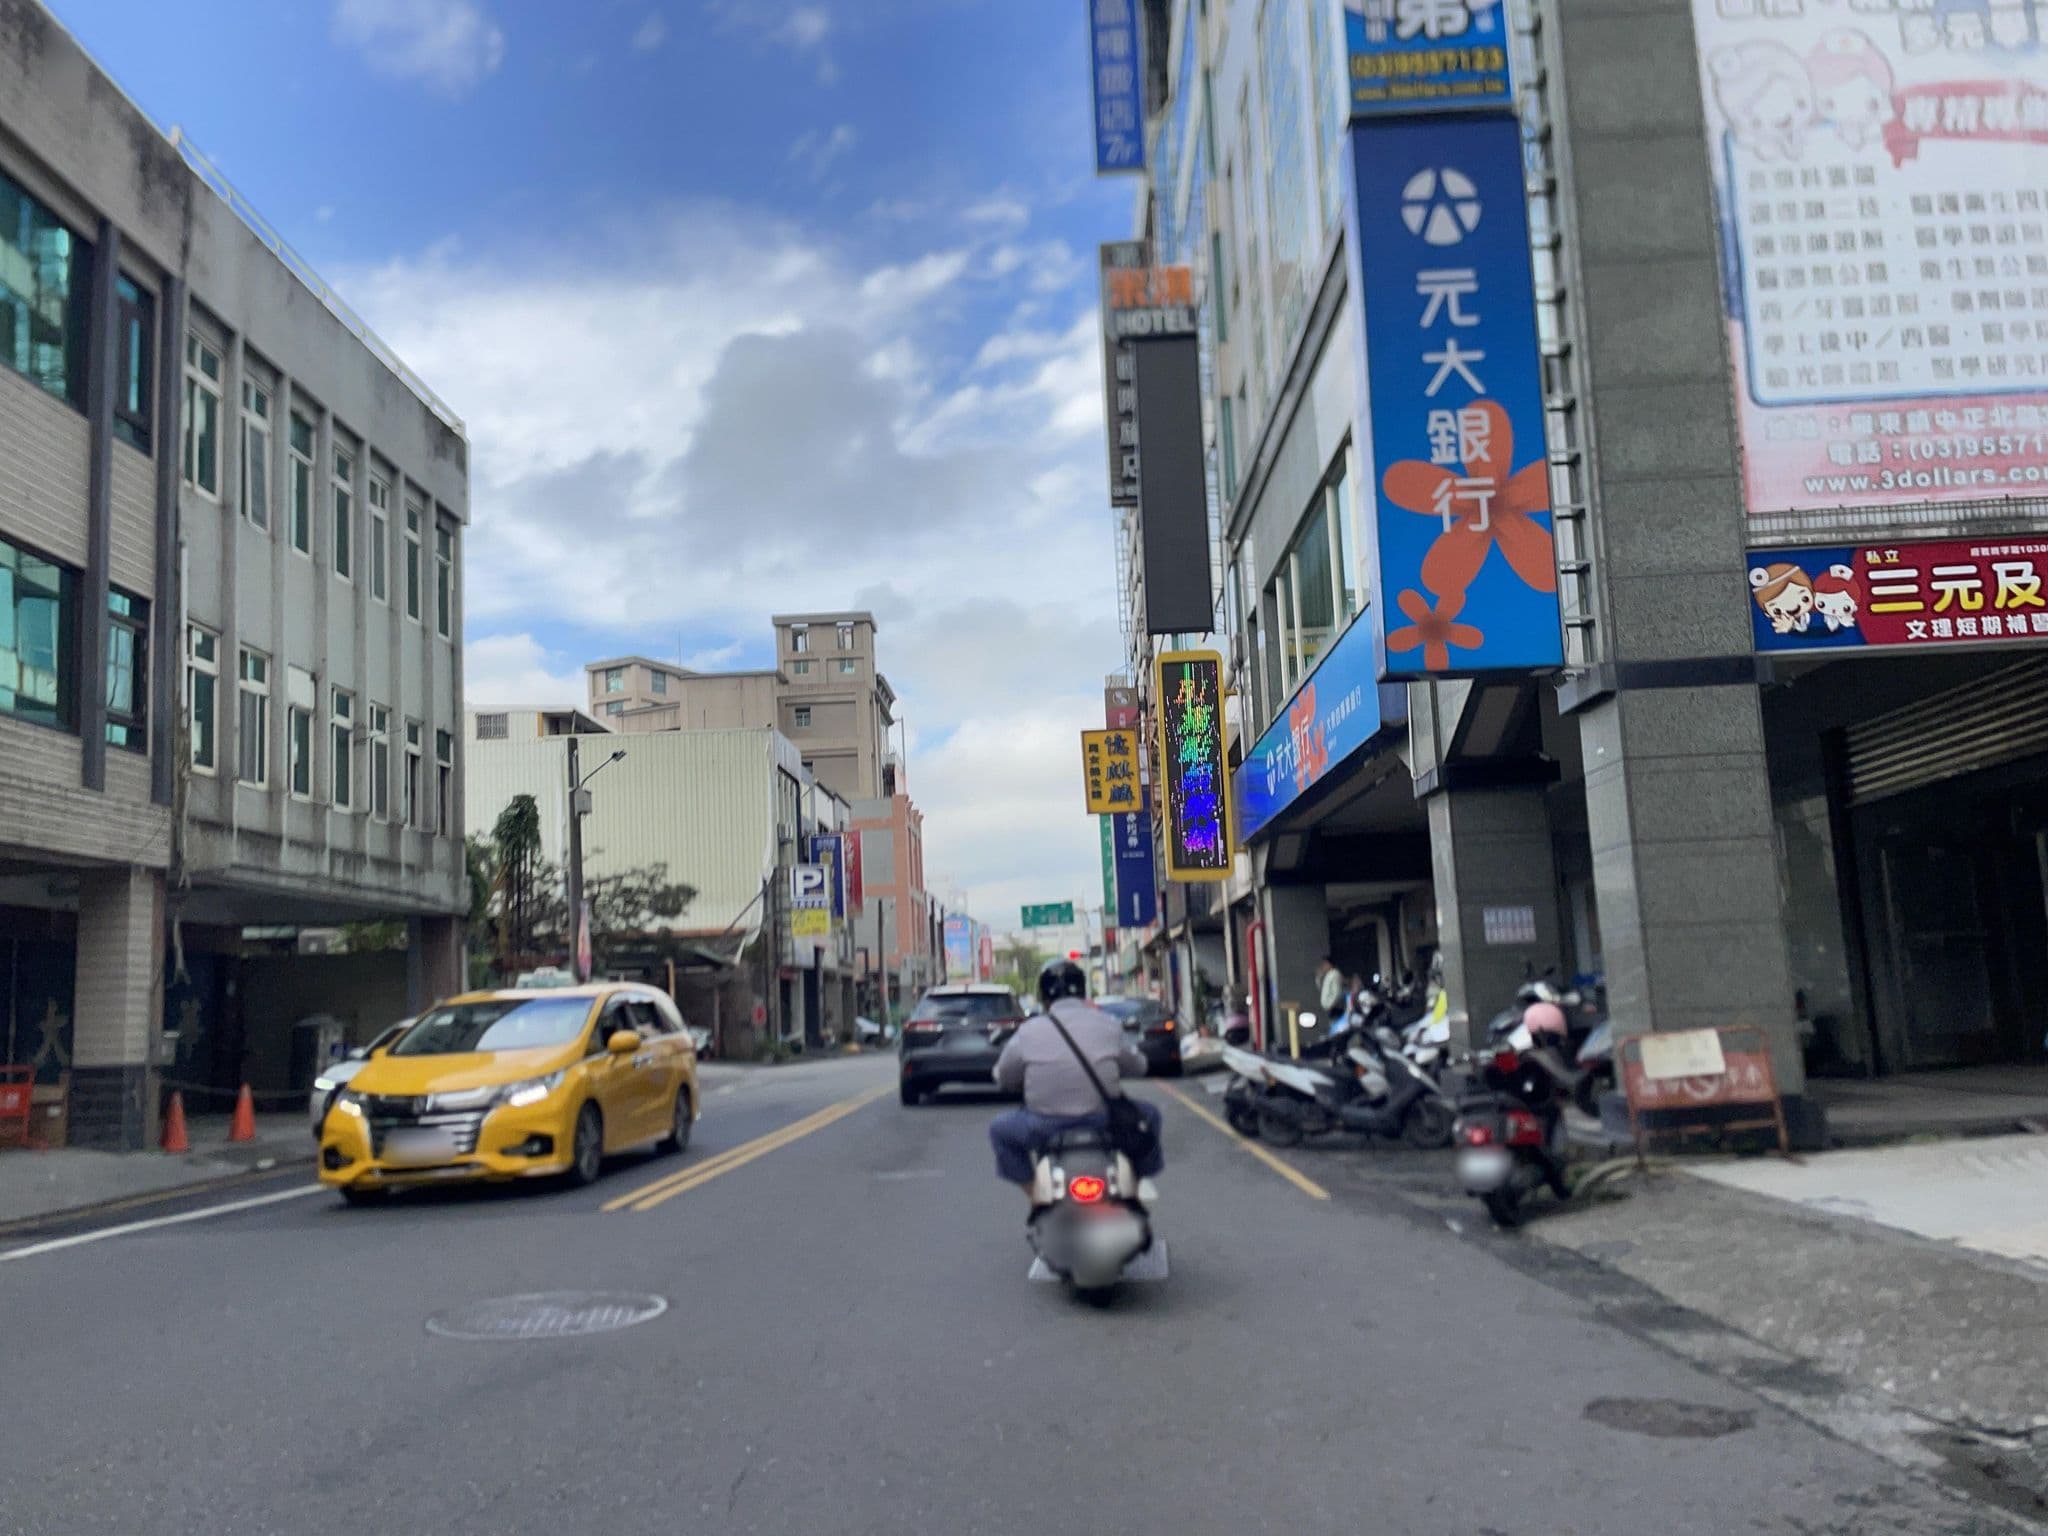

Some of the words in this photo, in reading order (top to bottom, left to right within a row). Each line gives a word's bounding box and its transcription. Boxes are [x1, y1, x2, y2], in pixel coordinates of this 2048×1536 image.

[1113, 306, 1196, 336] HOTEL
[1416, 269, 1496, 533] 元大銀行
[1804, 466, 2048, 494] www.3dollars.co
[1865, 549, 1900, 565] 私立
[1868, 561, 2046, 613] 三元及
[1276, 714, 1311, 782] 元大銀行
[796, 867, 822, 897] P
